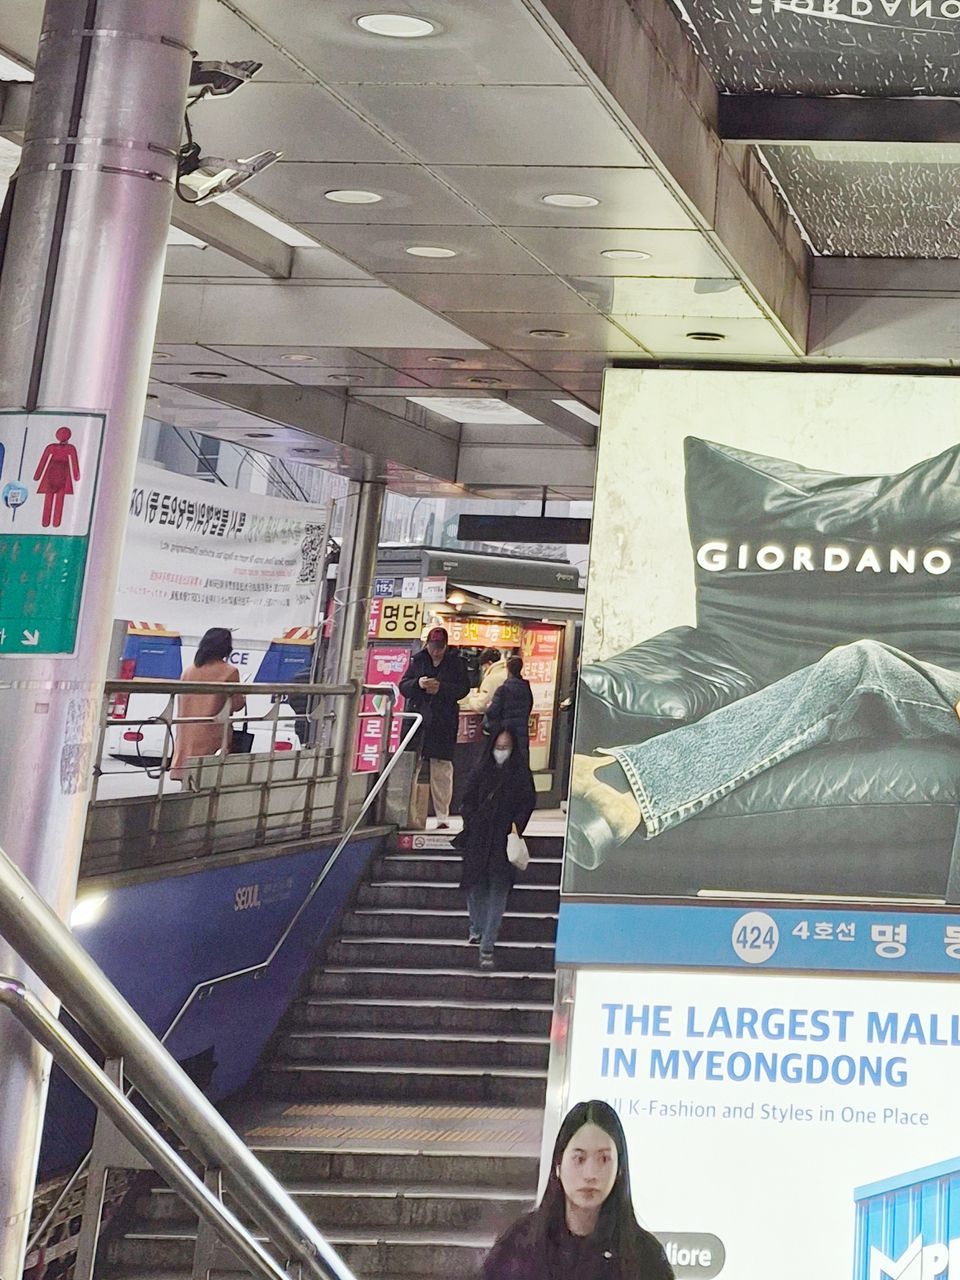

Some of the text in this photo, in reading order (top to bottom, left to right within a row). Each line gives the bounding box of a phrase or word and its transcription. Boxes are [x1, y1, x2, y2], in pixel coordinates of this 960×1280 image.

[697, 541, 951, 575] GIORDANO
[383, 604, 421, 632] 명당
[736, 924, 775, 950] 424
[791, 920, 856, 942] 4호선
[601, 1003, 672, 1037] THE
[685, 1006, 854, 1043] LARGEST
[601, 1047, 908, 1088] IN MYEONGDONG
[628, 1098, 716, 1118] K-Fashion
[722, 1102, 754, 1119] and
[761, 1102, 813, 1124] Styles
[819, 1106, 835, 1122] in
[841, 1107, 877, 1124] One
[883, 1107, 929, 1126] Place
